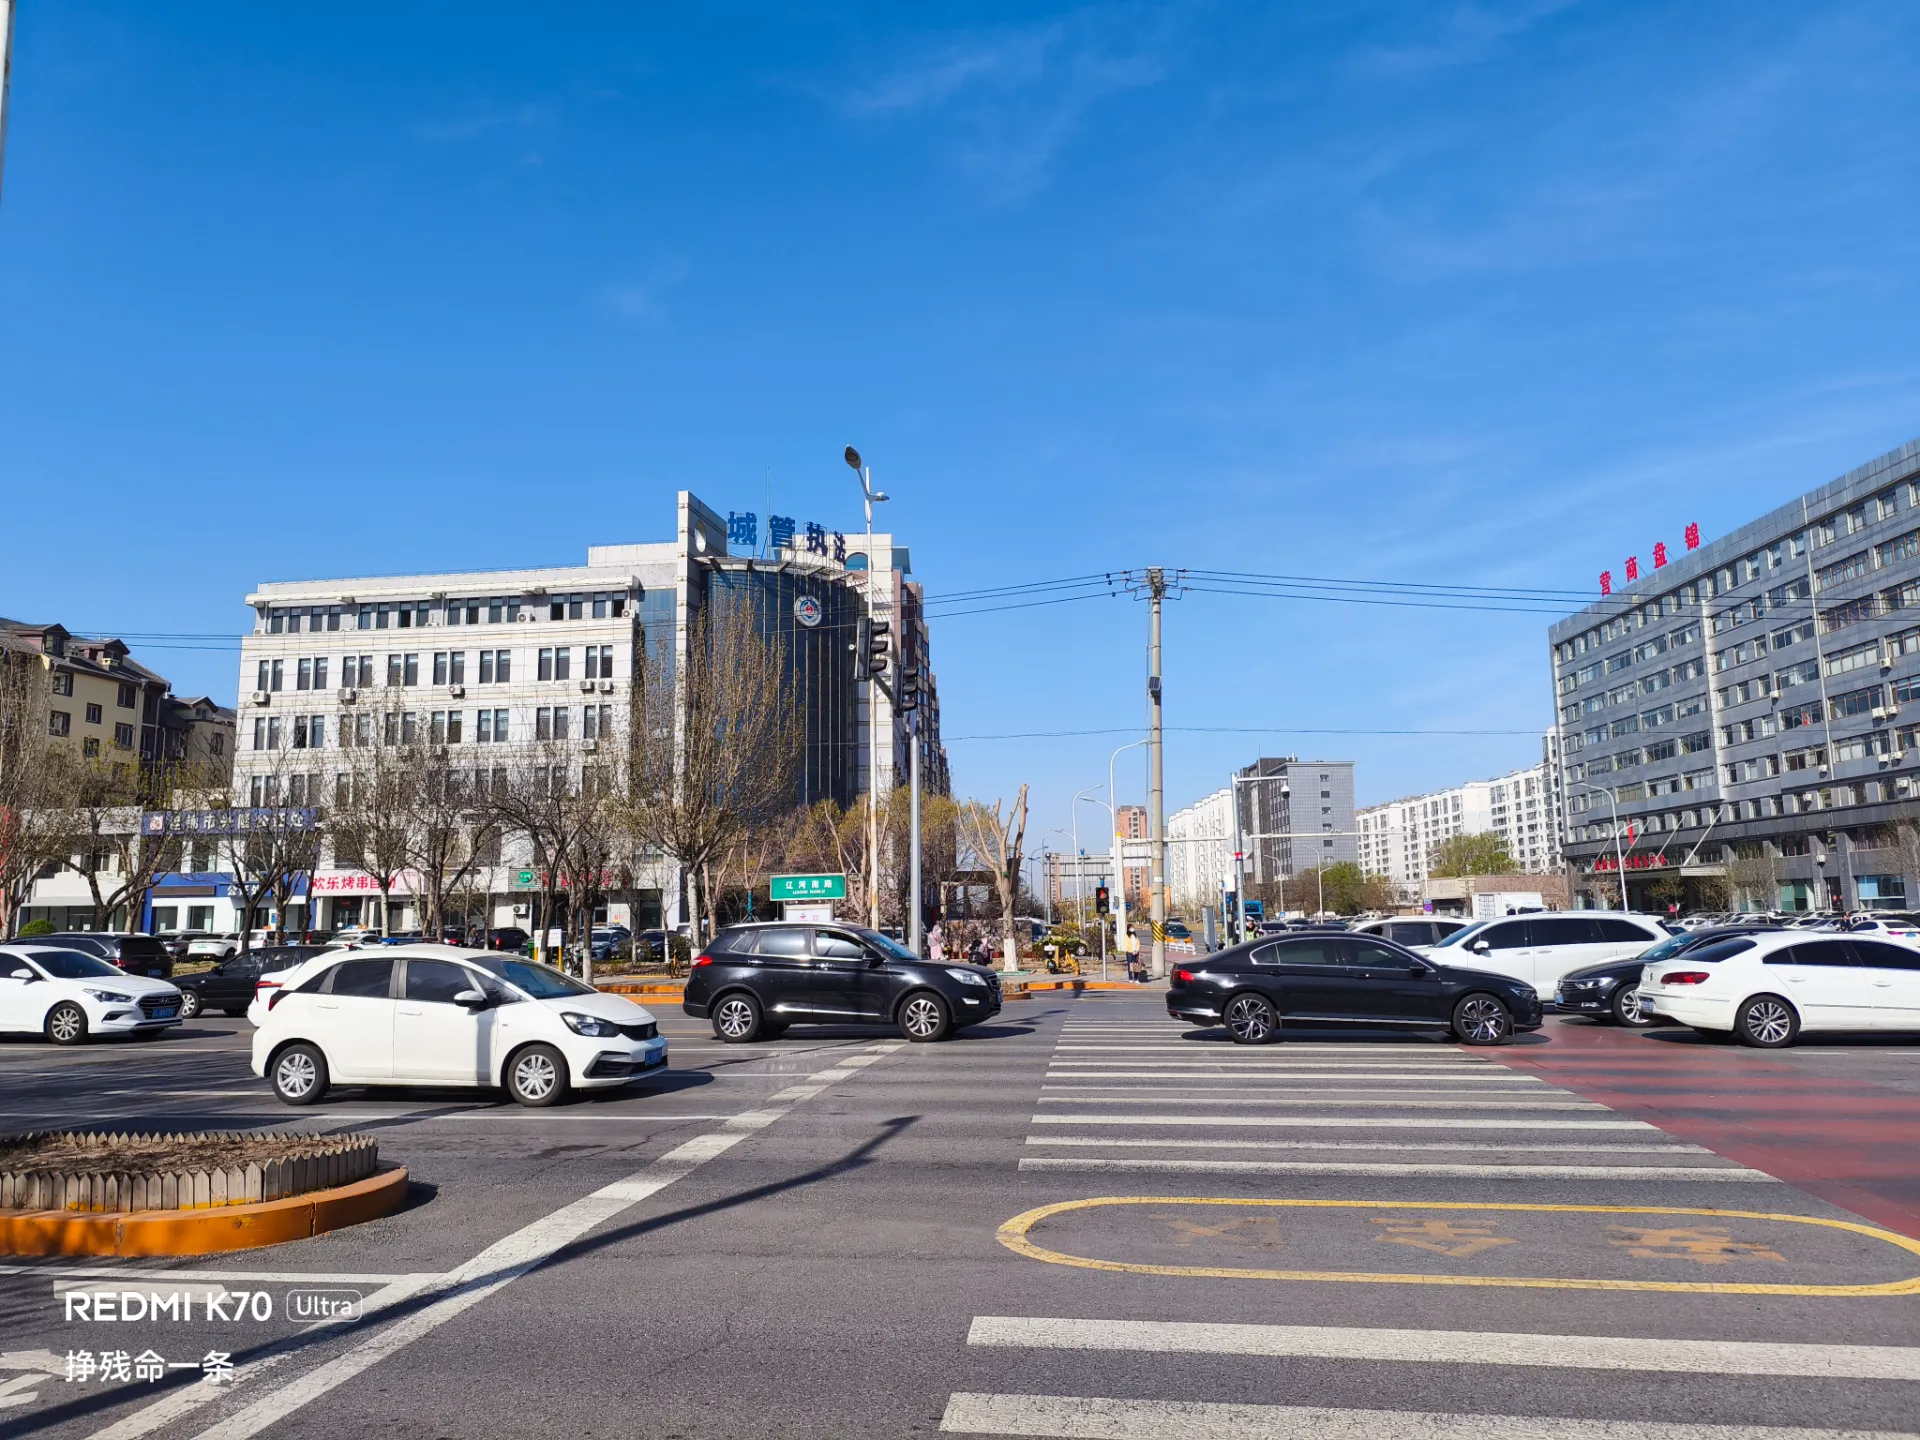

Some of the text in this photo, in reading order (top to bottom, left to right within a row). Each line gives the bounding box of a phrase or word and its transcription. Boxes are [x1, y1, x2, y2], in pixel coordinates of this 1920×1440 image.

[727, 510, 847, 565] 城管执法
[1598, 521, 1701, 597] 营商盘锦
[785, 879, 832, 890] 辽河南路
